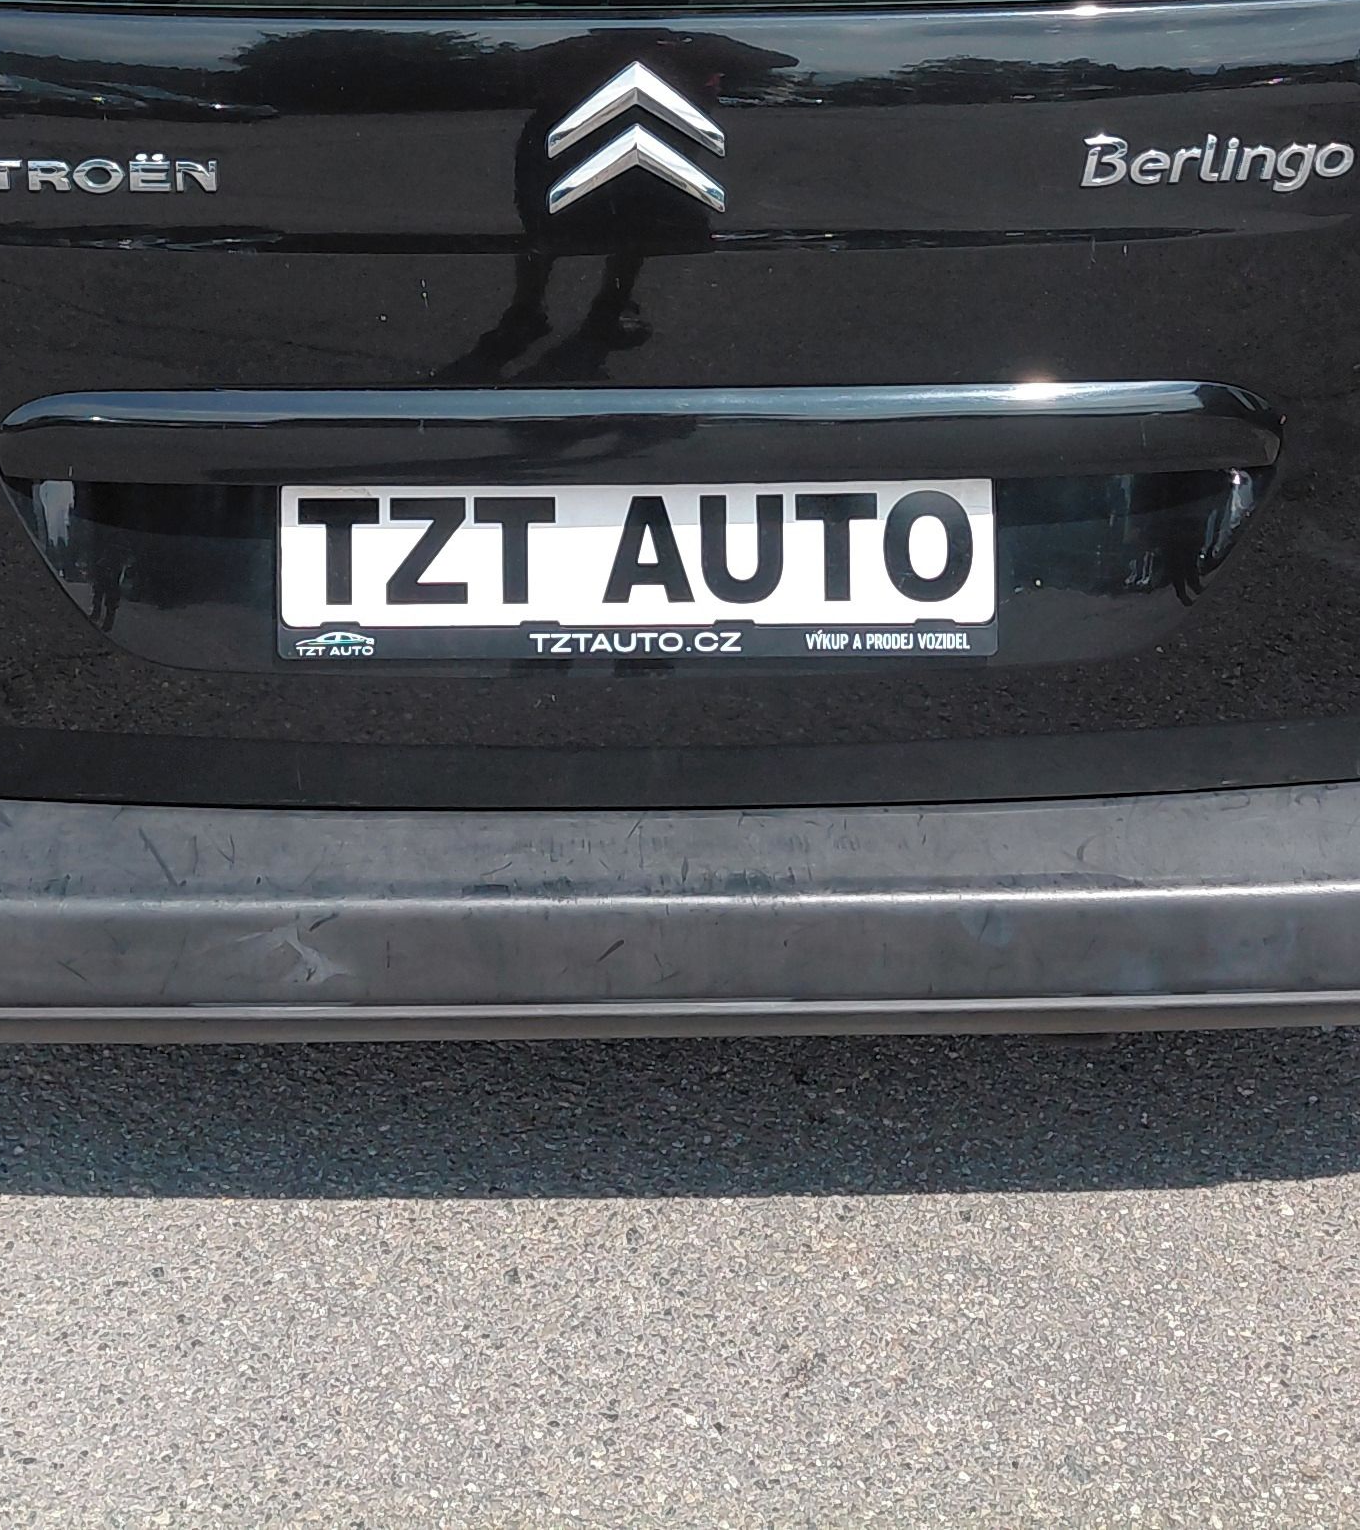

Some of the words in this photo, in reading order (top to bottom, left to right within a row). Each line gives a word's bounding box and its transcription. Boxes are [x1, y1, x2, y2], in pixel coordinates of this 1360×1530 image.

[1080, 133, 1355, 192] Berlingo
[297, 495, 557, 606] TZT
[602, 490, 974, 605] AUTO
[529, 632, 742, 653] TZTAUTO.CZ
[805, 629, 849, 650] VÝKUP
[852, 633, 862, 650] A
[866, 633, 914, 650] PRODEJ
[917, 633, 971, 650] VOZIDEL
[295, 646, 326, 657] TZT
[329, 645, 374, 656] AUTO
